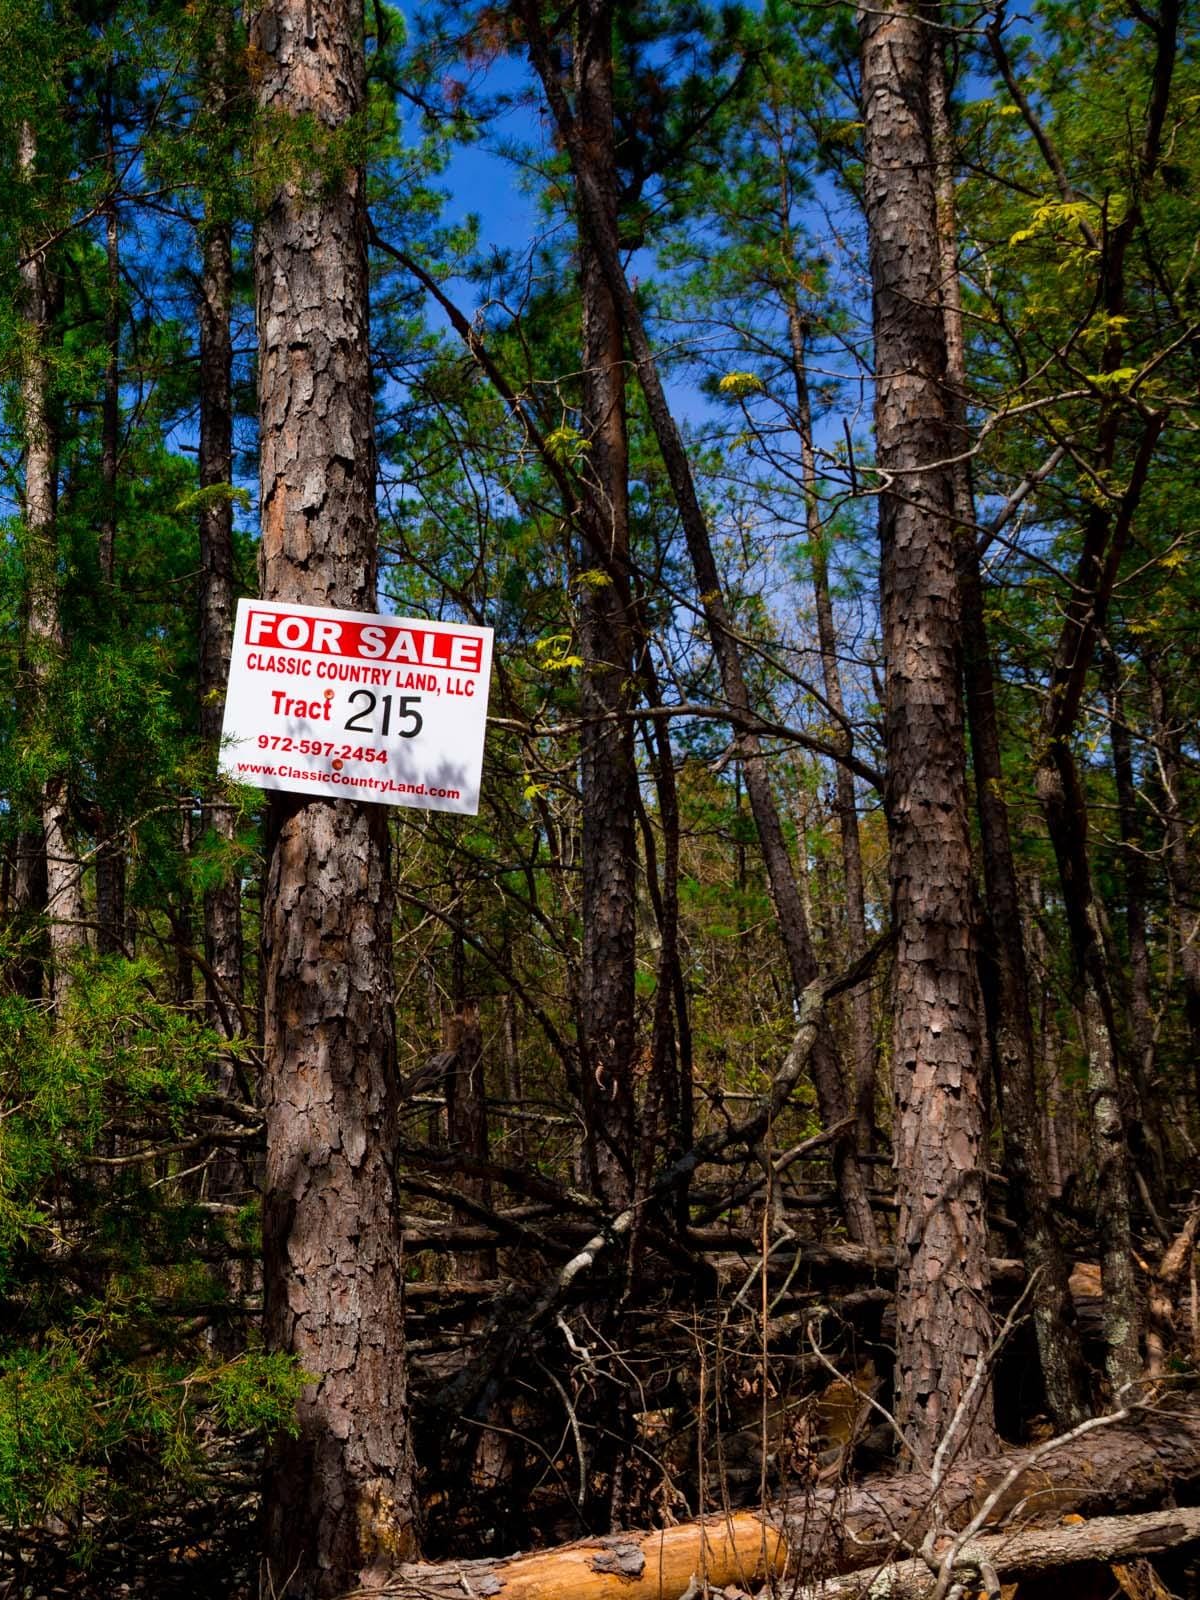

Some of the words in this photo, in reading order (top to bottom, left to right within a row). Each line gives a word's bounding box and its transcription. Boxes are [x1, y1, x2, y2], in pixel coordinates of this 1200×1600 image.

[249, 613, 343, 654] FOR
[358, 627, 479, 670] SALE
[247, 653, 311, 676] CLASSIC
[316, 662, 392, 686] COUNTRY
[396, 671, 440, 696] LAND,
[446, 678, 474, 696] LLC
[272, 691, 332, 720] Tract
[344, 690, 422, 738] 215
[258, 735, 388, 764] 972-597-2454
[238, 762, 460, 799] www.ClassicCountryLand.com
